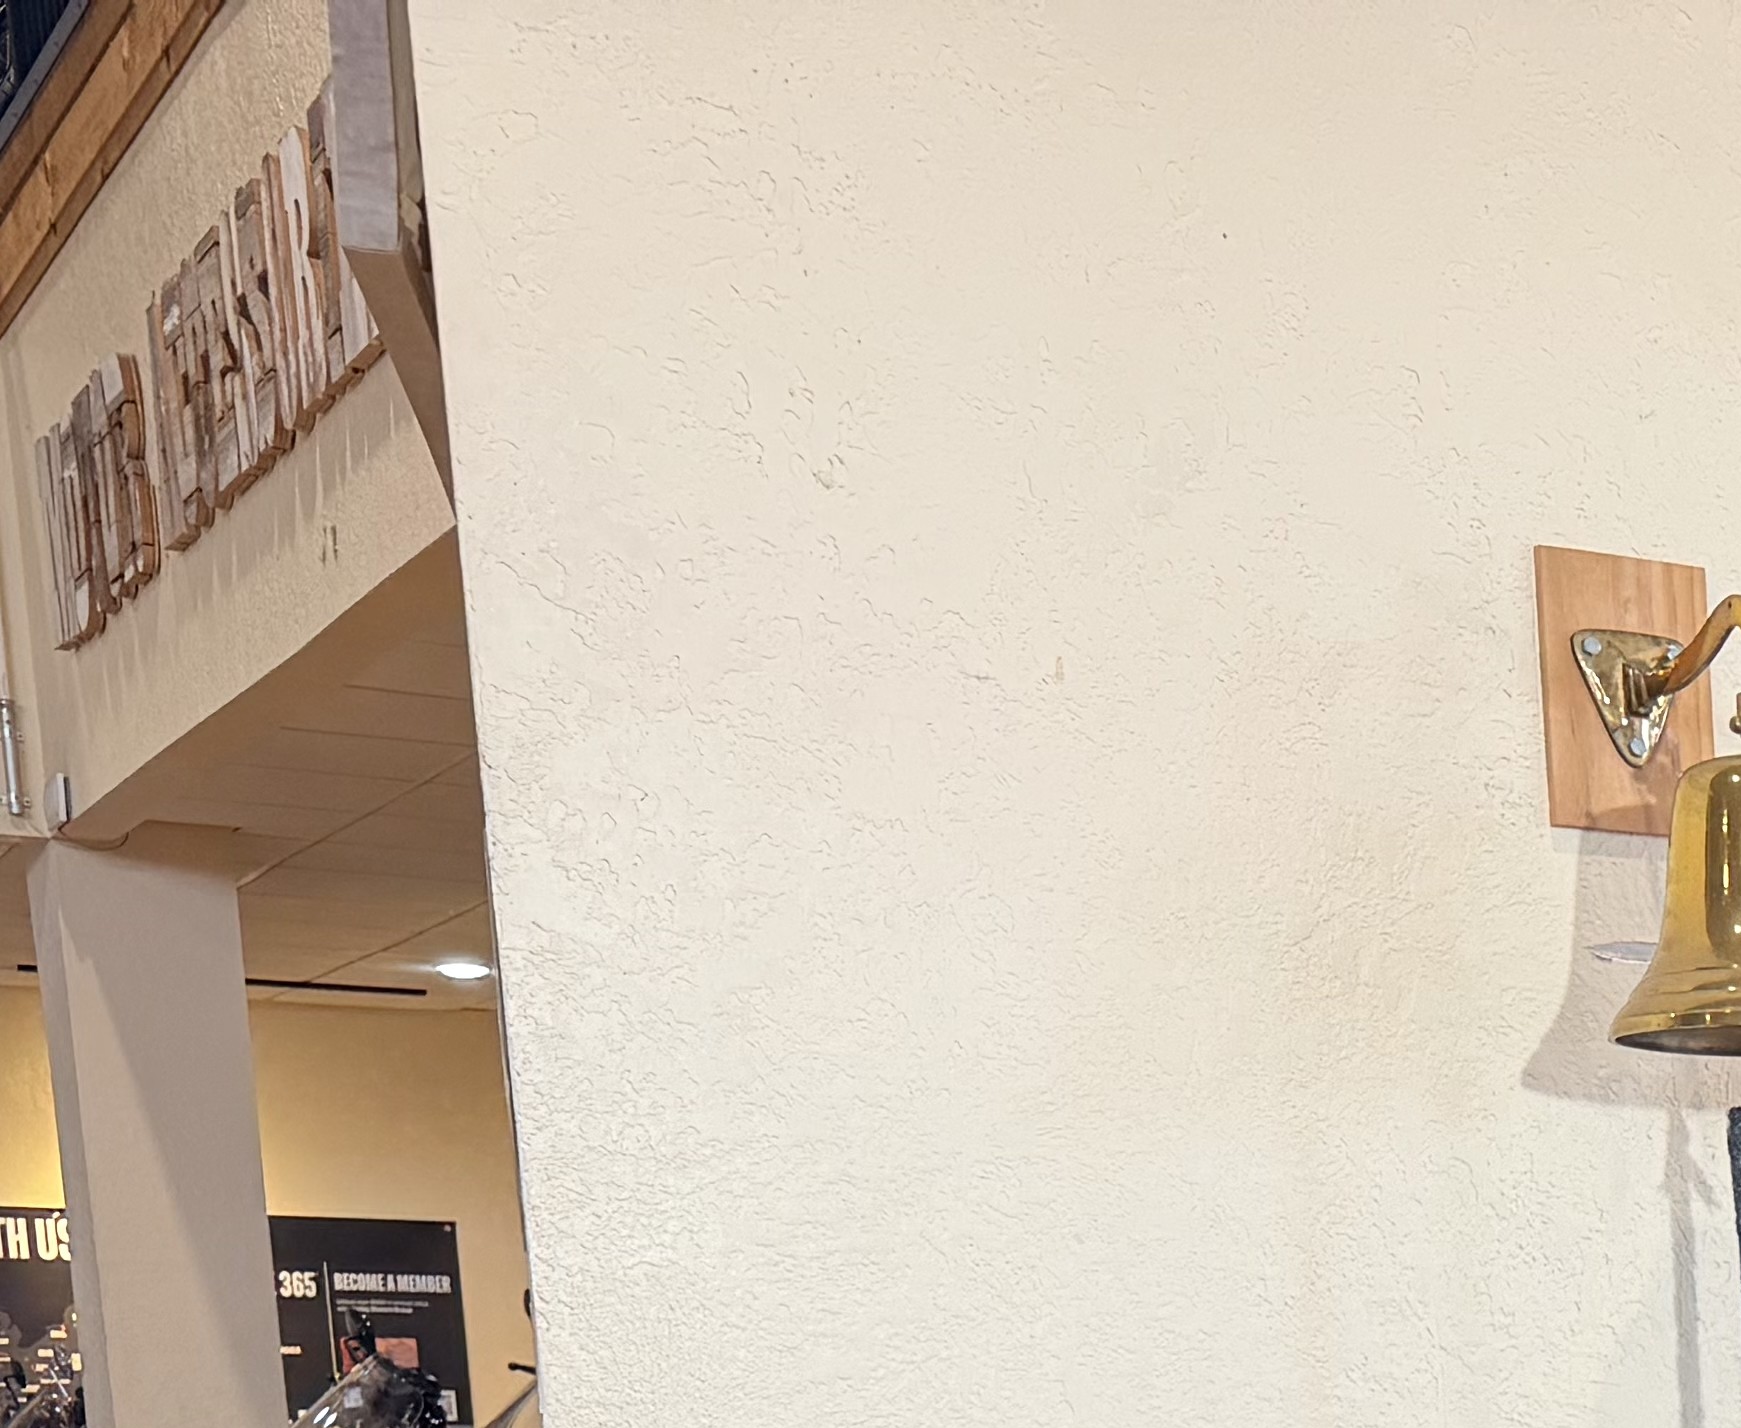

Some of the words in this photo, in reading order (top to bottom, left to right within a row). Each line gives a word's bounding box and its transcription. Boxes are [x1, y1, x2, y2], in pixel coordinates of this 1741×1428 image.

[278, 1270, 317, 1299] 365
[333, 1272, 385, 1293] BECOME
[386, 1274, 396, 1292] A
[396, 1275, 452, 1294] MEMBER
